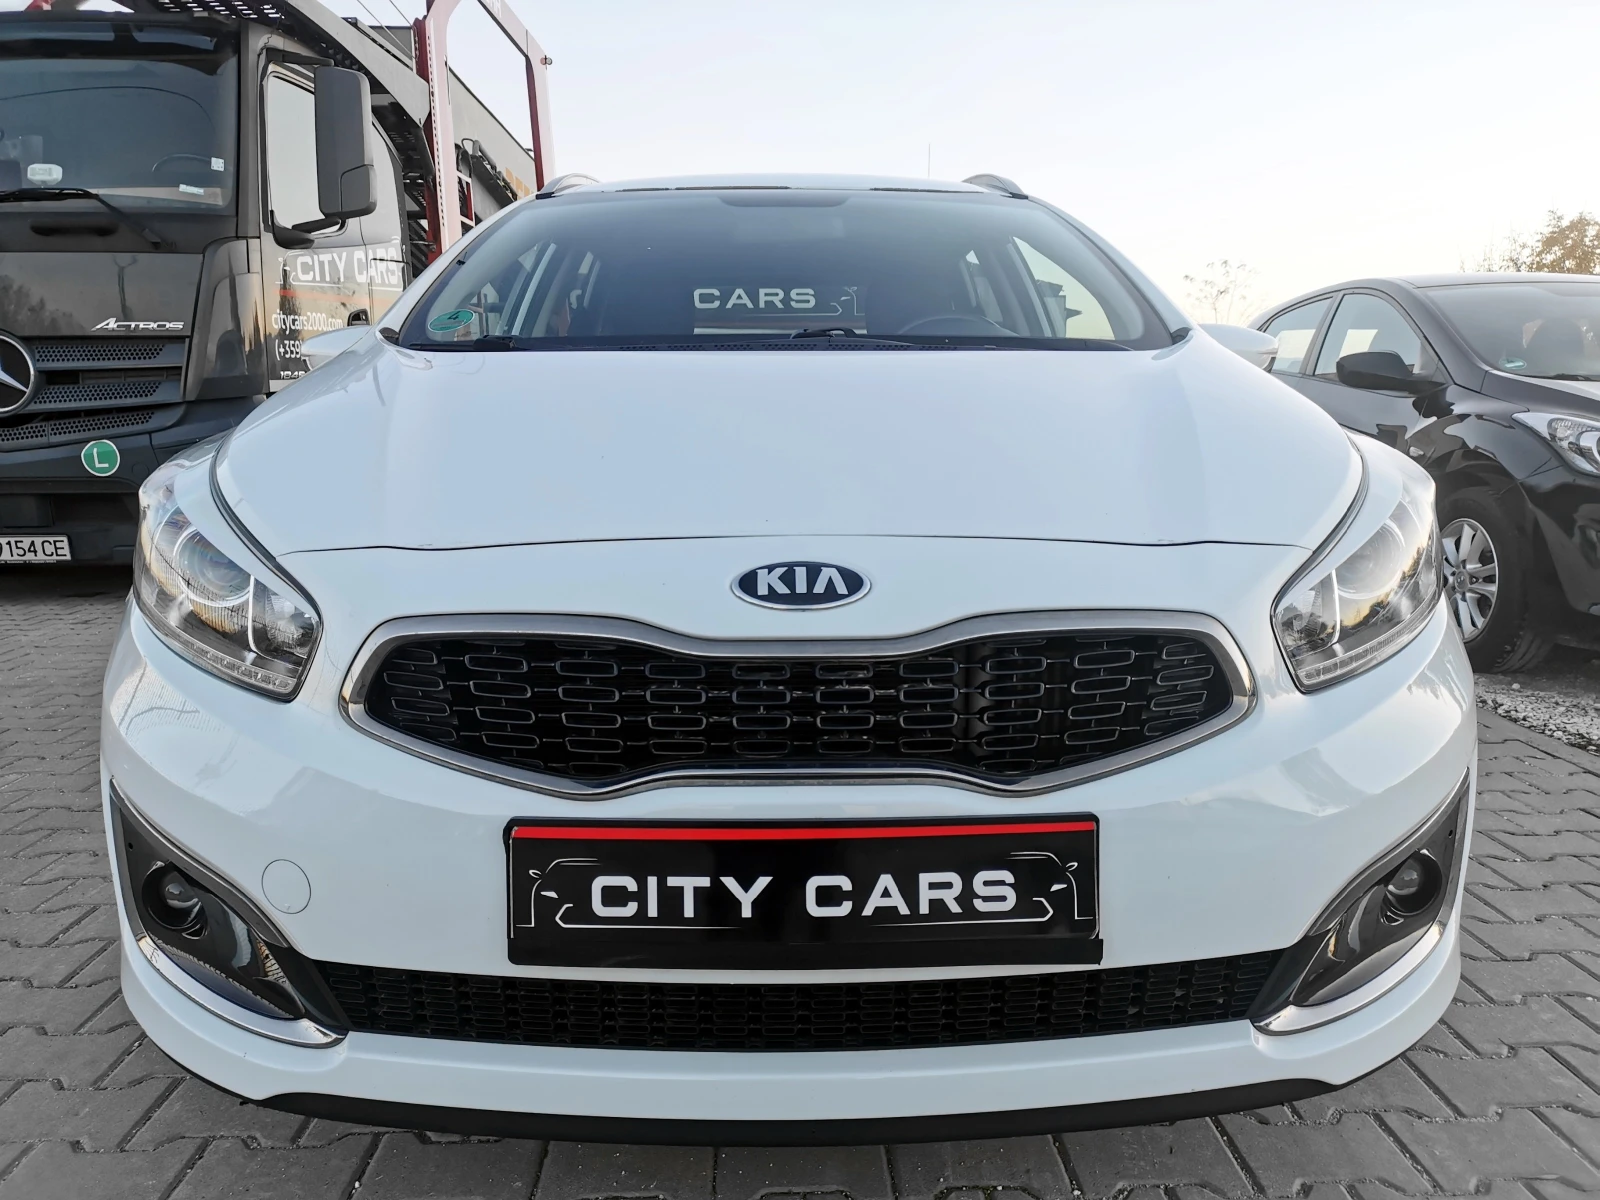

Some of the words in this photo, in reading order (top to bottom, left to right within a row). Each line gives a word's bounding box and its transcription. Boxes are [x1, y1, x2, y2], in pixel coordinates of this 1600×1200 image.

[296, 251, 347, 282] CITY
[353, 247, 399, 284] CARS
[693, 288, 816, 309] CARS
[271, 309, 344, 334] citycars2000.com
[93, 447, 109, 468] L
[0, 540, 38, 557] 154
[41, 540, 67, 557] CE
[755, 566, 849, 596] KIA
[590, 875, 774, 918] CITY
[804, 869, 1018, 918] CARS
